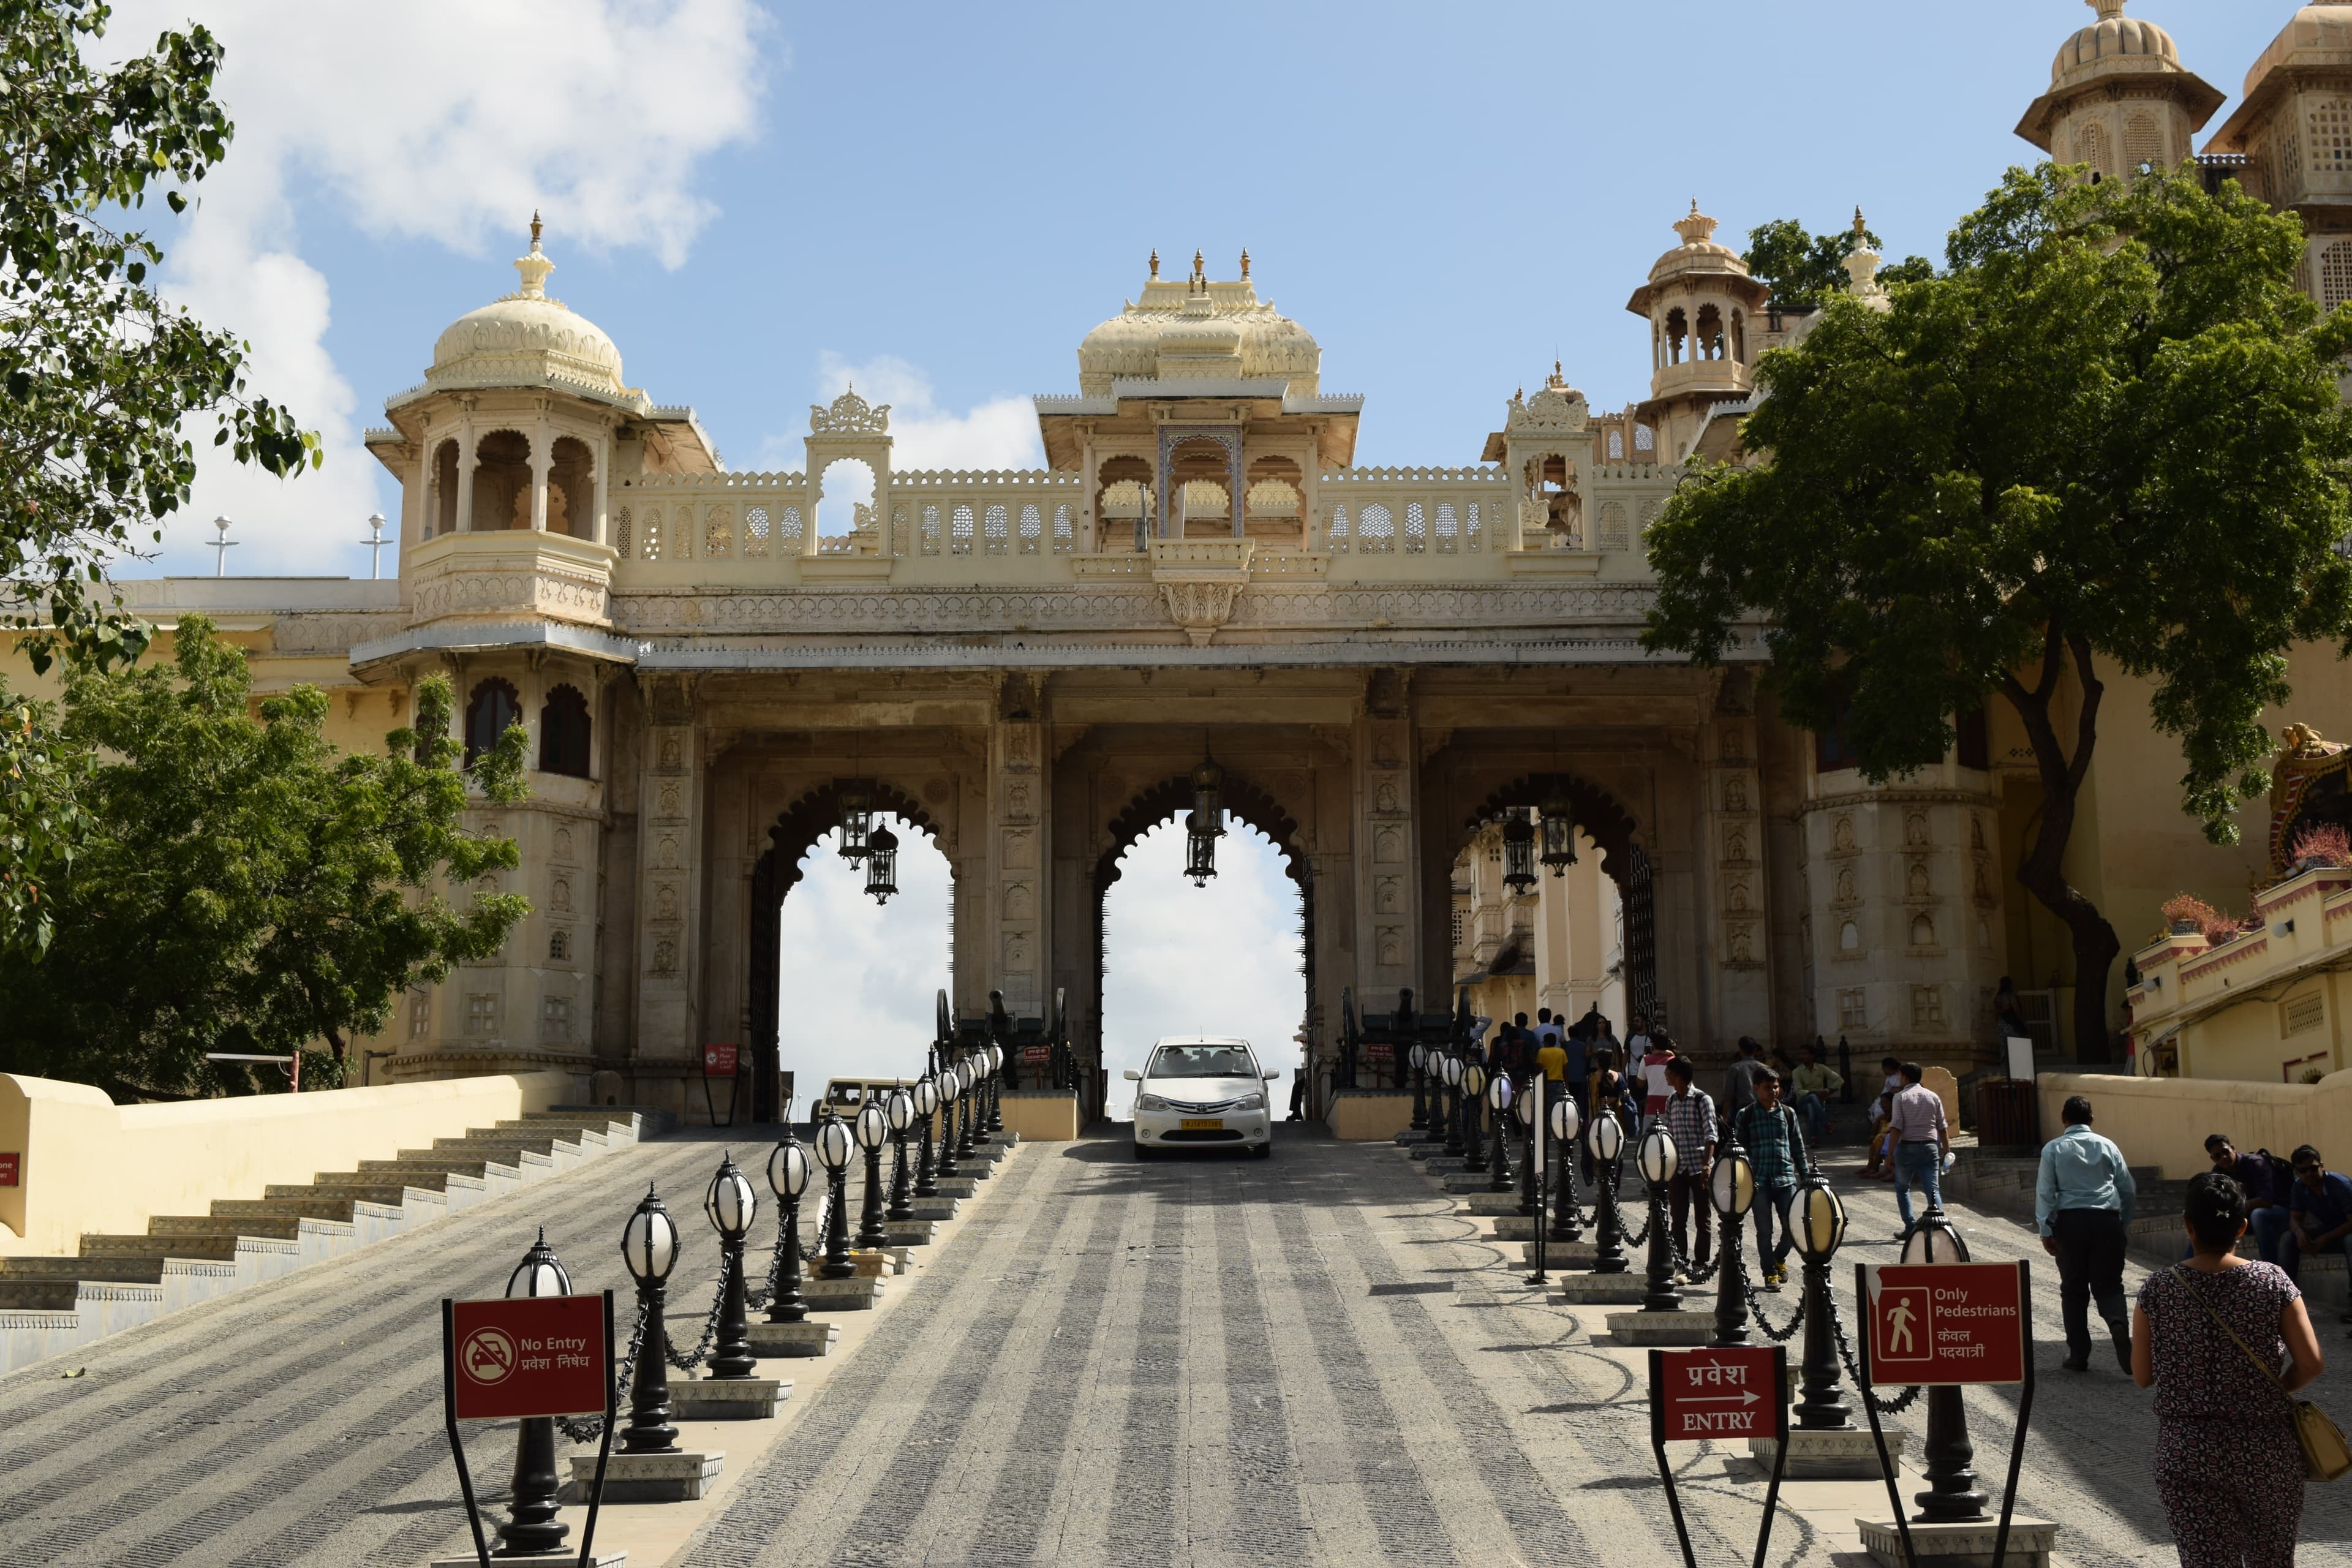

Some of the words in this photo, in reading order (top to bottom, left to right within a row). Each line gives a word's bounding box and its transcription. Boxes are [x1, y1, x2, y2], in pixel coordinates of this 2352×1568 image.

[1934, 1287, 1968, 1303] Only
[1935, 1304, 2016, 1317] Pedestrians
[1937, 1327, 1971, 1342] केवल
[521, 1338, 541, 1351] No
[546, 1337, 586, 1352] Entry
[1937, 1343, 1985, 1359] पदयात्री
[521, 1355, 551, 1370] प्रवेश
[556, 1354, 590, 1368] निषेध
[1686, 1357, 1748, 1386] प्रवेश
[1682, 1411, 1756, 1431] ENTRY
